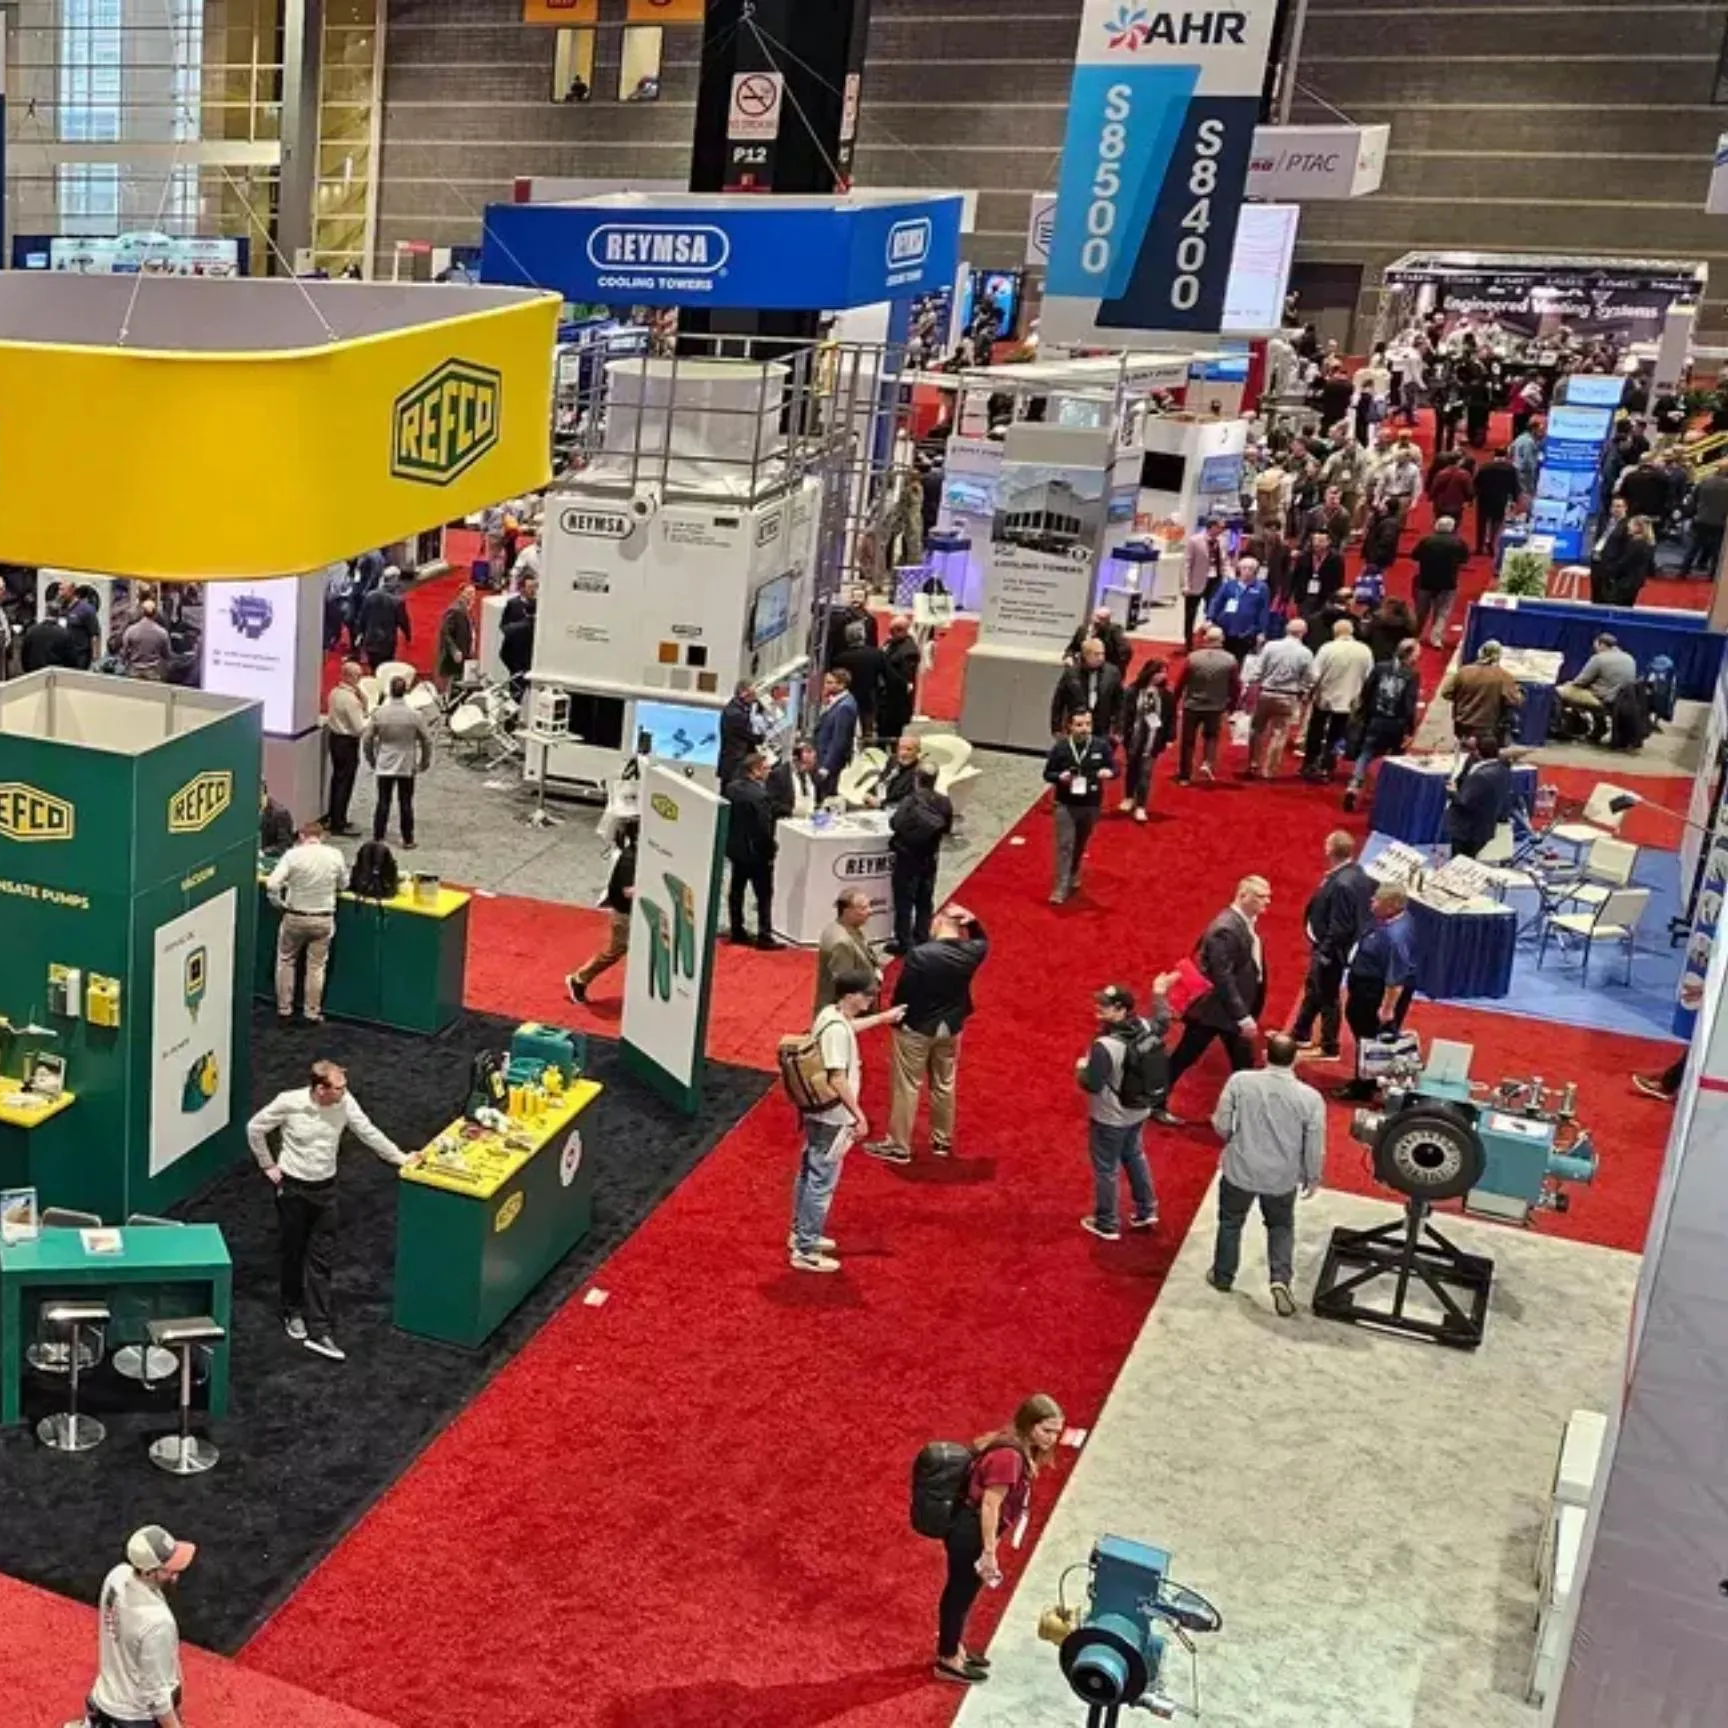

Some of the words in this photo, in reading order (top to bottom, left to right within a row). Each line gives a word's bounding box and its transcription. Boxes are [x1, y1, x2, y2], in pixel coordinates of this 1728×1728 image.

[1144, 11, 1248, 44] AHR
[733, 146, 767, 163] P12
[1286, 154, 1340, 171] PTAC
[1083, 84, 1132, 273] S8500
[1171, 119, 1224, 310] S8400
[606, 232, 709, 263] REYMSA
[598, 276, 654, 288] COOLING
[659, 278, 713, 290] TOWERS
[1443, 294, 1529, 314] Engineered
[399, 379, 493, 466] REFCO
[568, 514, 625, 533] REYMSA
[173, 780, 226, 822] REFCO
[844, 852, 896, 875] REYMS
[42, 889, 90, 909] PUMPS
